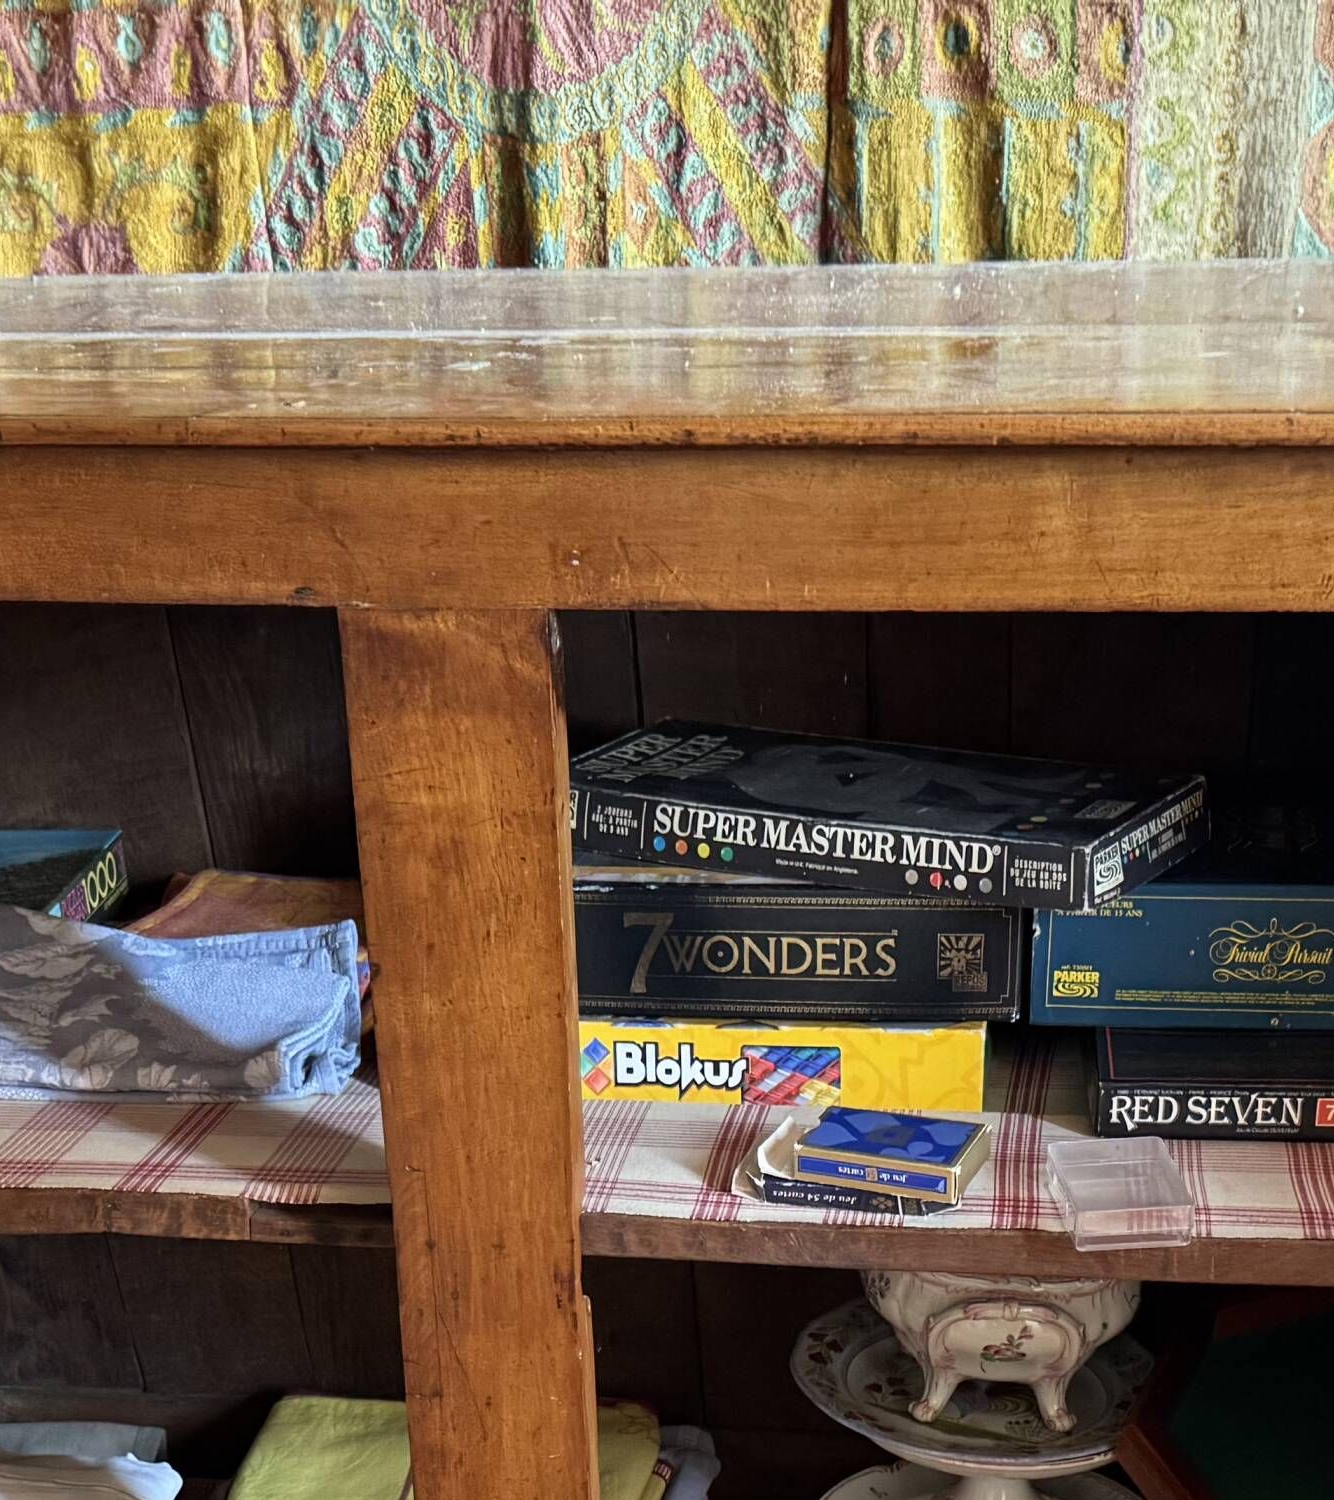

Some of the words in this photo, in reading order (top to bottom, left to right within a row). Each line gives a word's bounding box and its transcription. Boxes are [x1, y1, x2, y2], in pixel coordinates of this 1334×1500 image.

[575, 734, 683, 771] SUPER
[1120, 824, 1150, 854] SUPER
[1148, 804, 1183, 838] MASTER
[653, 803, 758, 847] SUPER
[760, 817, 896, 865] MASTER
[899, 834, 995, 875] MIND
[1014, 858, 1063, 872] DESCRIPTION
[1023, 869, 1036, 879] JEU
[1039, 871, 1049, 880] AU
[1052, 872, 1067, 882] DOS
[81, 851, 117, 915] 1000
[1028, 878, 1037, 888] LA
[1100, 908, 1112, 917] DE
[1125, 910, 1144, 918] ANS
[623, 912, 675, 994] 7
[666, 934, 897, 976] WONDERS
[1210, 937, 1270, 966] Trivial
[1267, 940, 1333, 966] Pursuit
[1054, 970, 1100, 983] PARKER
[615, 1041, 749, 1098] Blokus
[1109, 1095, 1178, 1132] RED
[1185, 1092, 1304, 1126] SEVEN
[838, 1166, 864, 1176] cartes
[879, 1172, 890, 1182] de
[773, 1190, 805, 1200] cartes
[807, 1192, 821, 1201] 54
[824, 1193, 836, 1203] de
[839, 1195, 857, 1205] Jeu
